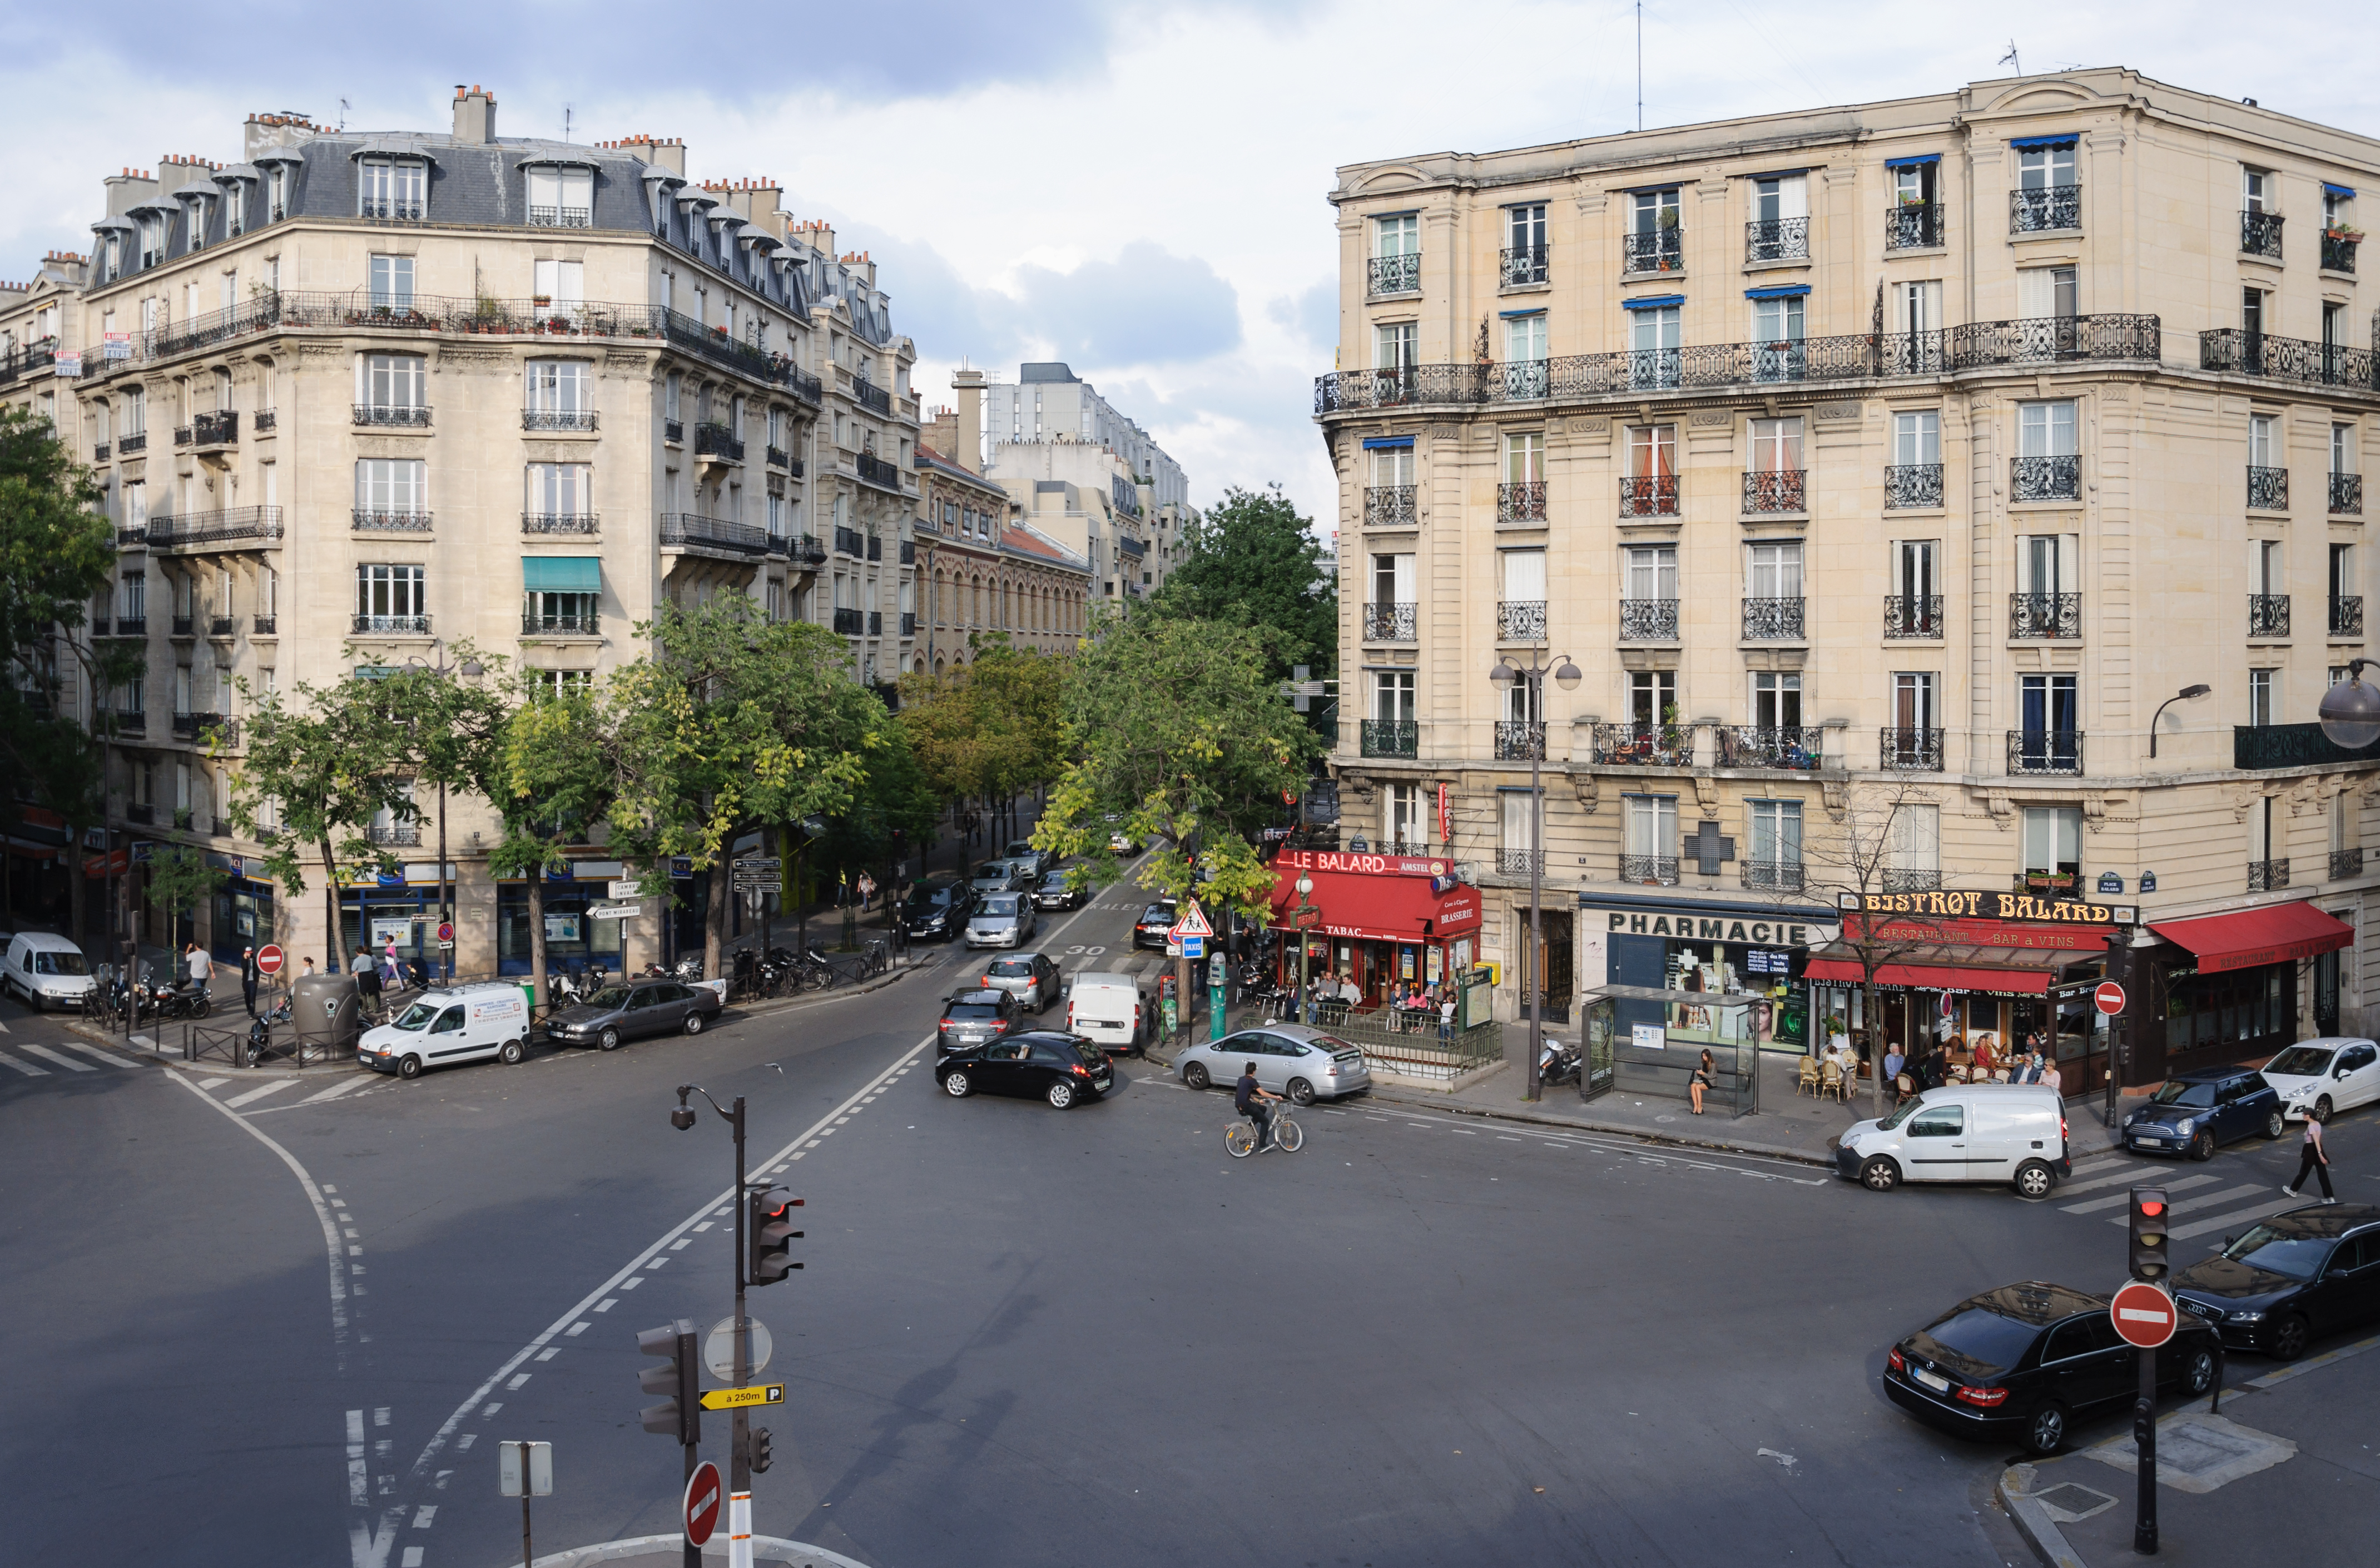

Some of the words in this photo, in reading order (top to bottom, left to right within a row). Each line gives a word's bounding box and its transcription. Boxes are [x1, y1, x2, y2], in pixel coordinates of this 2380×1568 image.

[1294, 852, 1311, 868] LE
[1318, 853, 1385, 873] BALARD
[1401, 862, 1429, 873] AMSTEL
[1865, 892, 1982, 916] BISTROT
[1997, 893, 2110, 923] BALARD
[1441, 908, 1473, 924] BRASSERIE
[1326, 926, 1362, 937] TABAC
[1609, 913, 1806, 944] PHARMACIE
[1883, 928, 1970, 943] RESTAURANT
[1993, 934, 2019, 945] BAR
[2025, 934, 2034, 946] à
[2038, 936, 2075, 947] VINS
[1065, 946, 1106, 956] 30
[2220, 951, 2275, 969] RESTAURANT
[2289, 946, 2305, 958] BAR
[2079, 986, 2098, 994] Bras
[1591, 1067, 1612, 1082] PRINTEPS
[735, 1393, 760, 1402] 250m
[770, 1388, 779, 1400] P
